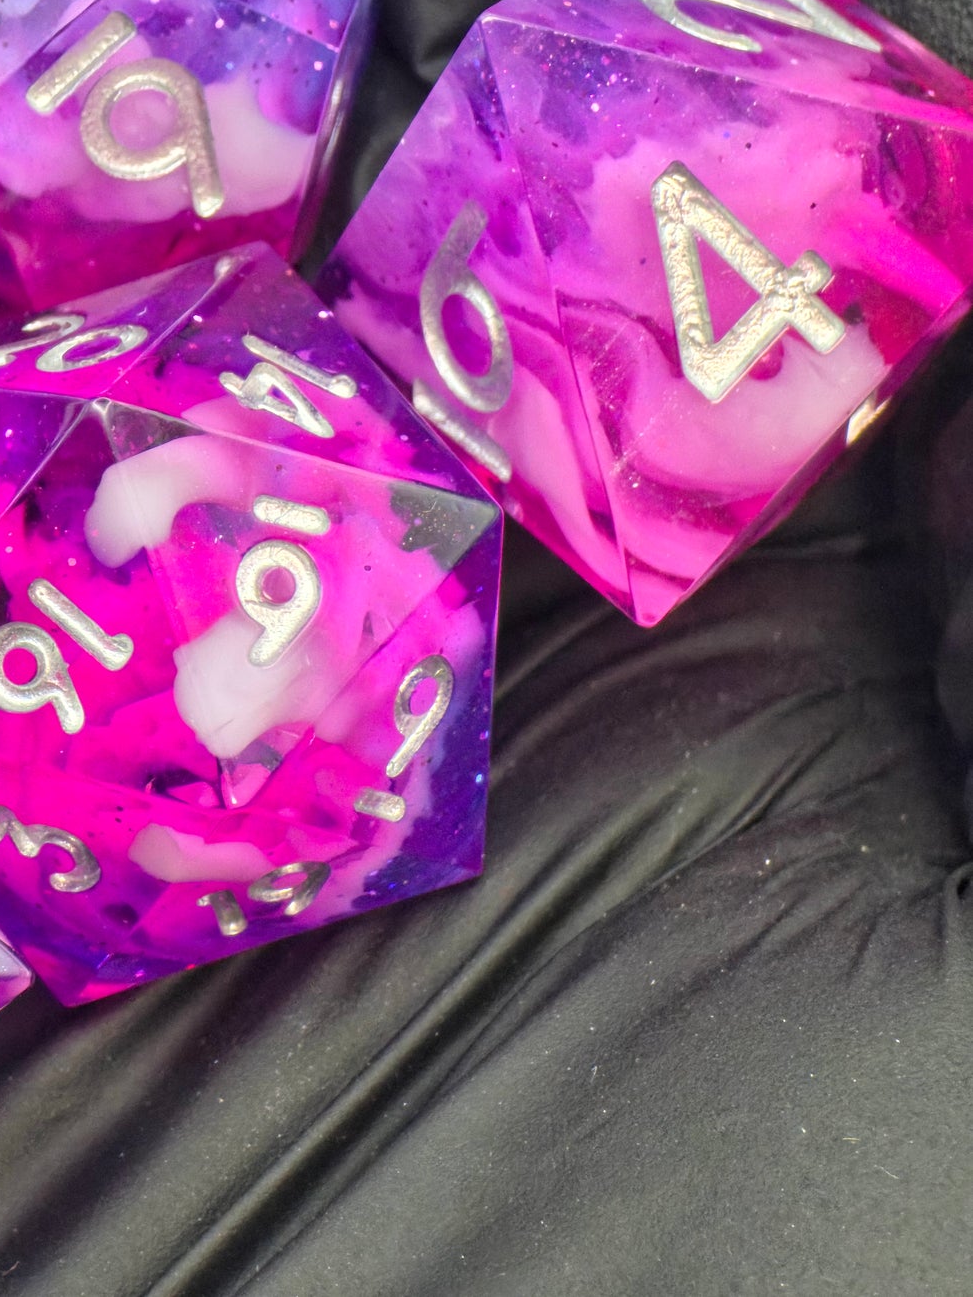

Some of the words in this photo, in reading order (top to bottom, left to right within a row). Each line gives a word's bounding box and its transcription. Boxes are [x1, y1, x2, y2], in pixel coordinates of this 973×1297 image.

[25, 10, 224, 219] 6
[218, 333, 358, 439] 14
[411, 201, 514, 485] 6
[650, 159, 847, 405] 4
[353, 653, 456, 823] 9
